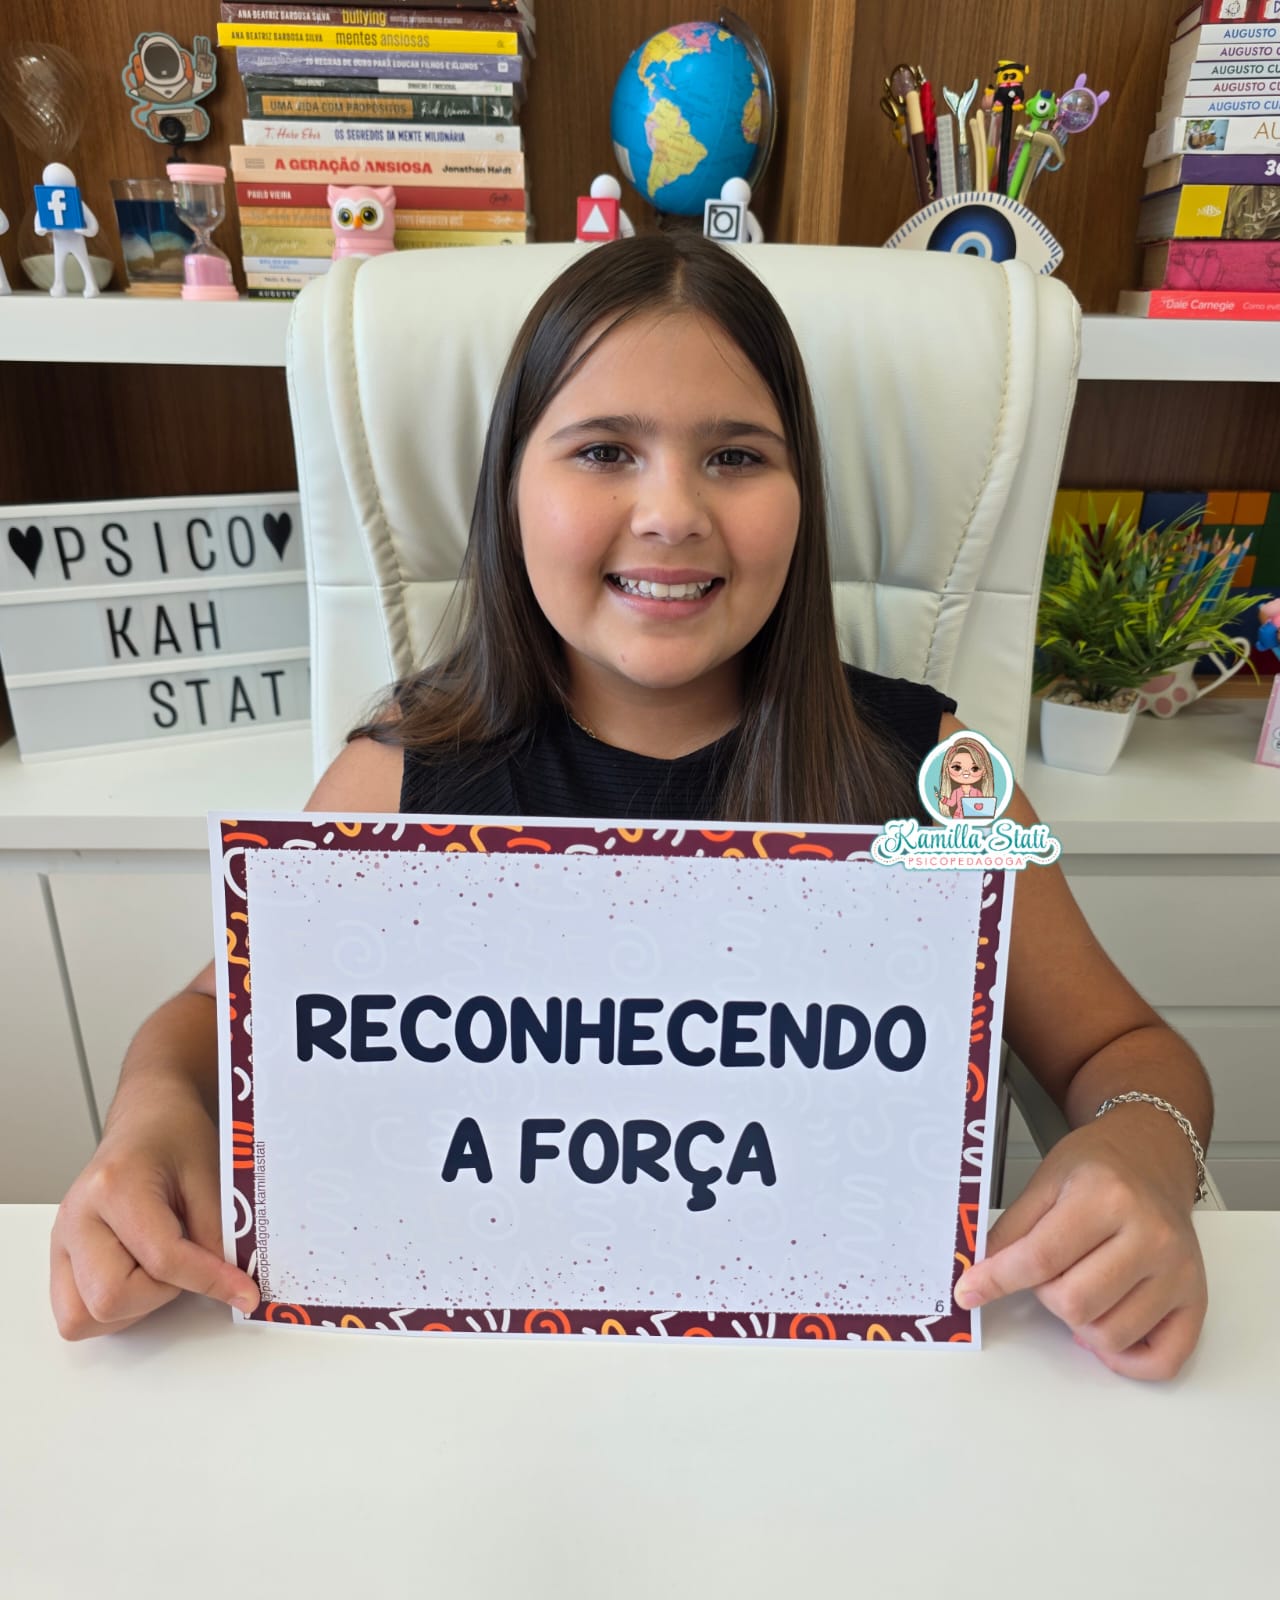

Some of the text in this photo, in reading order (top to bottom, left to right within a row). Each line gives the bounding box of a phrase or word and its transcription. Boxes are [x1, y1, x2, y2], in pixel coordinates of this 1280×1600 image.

[238, 9, 251, 19] ANA
[252, 9, 279, 20] BEATRIZ
[280, 11, 310, 21] BARBOSA
[312, 11, 331, 22] SILVA
[342, 8, 387, 26] bullying
[231, 31, 430, 48] ANA BEATRIZ BARBOSA SILVA mentes ansiosas
[1223, 28, 1277, 39] AUGUSTO
[1220, 47, 1273, 57] AUGUSTO
[1211, 64, 1264, 75] AUGUSTO
[1213, 81, 1266, 92] AUGUSTO
[270, 100, 293, 111] UMA
[321, 102, 344, 112] COM
[1208, 101, 1261, 112] AUGUSTO
[334, 128, 344, 140] OS
[347, 129, 384, 140] SEGREDOS
[387, 130, 396, 141] DA
[398, 130, 422, 142] MENTE
[275, 158, 286, 170] A
[289, 156, 360, 175] GERAÇÃO
[365, 160, 433, 174] ANSIOSA
[442, 165, 486, 174] Jonathan
[487, 165, 512, 174] Haidt
[247, 190, 292, 200] PAULO VIEIRA
[1190, 299, 1235, 312] Carnegie
[1242, 302, 1265, 310] Como
[53, 516, 256, 580] PSICO
[106, 600, 221, 659] KAH
[150, 669, 311, 728] STAT
[295, 993, 927, 1073] RECONHECENDO
[441, 1117, 777, 1212] A FORÇA
[934, 1299, 945, 1313] 6
